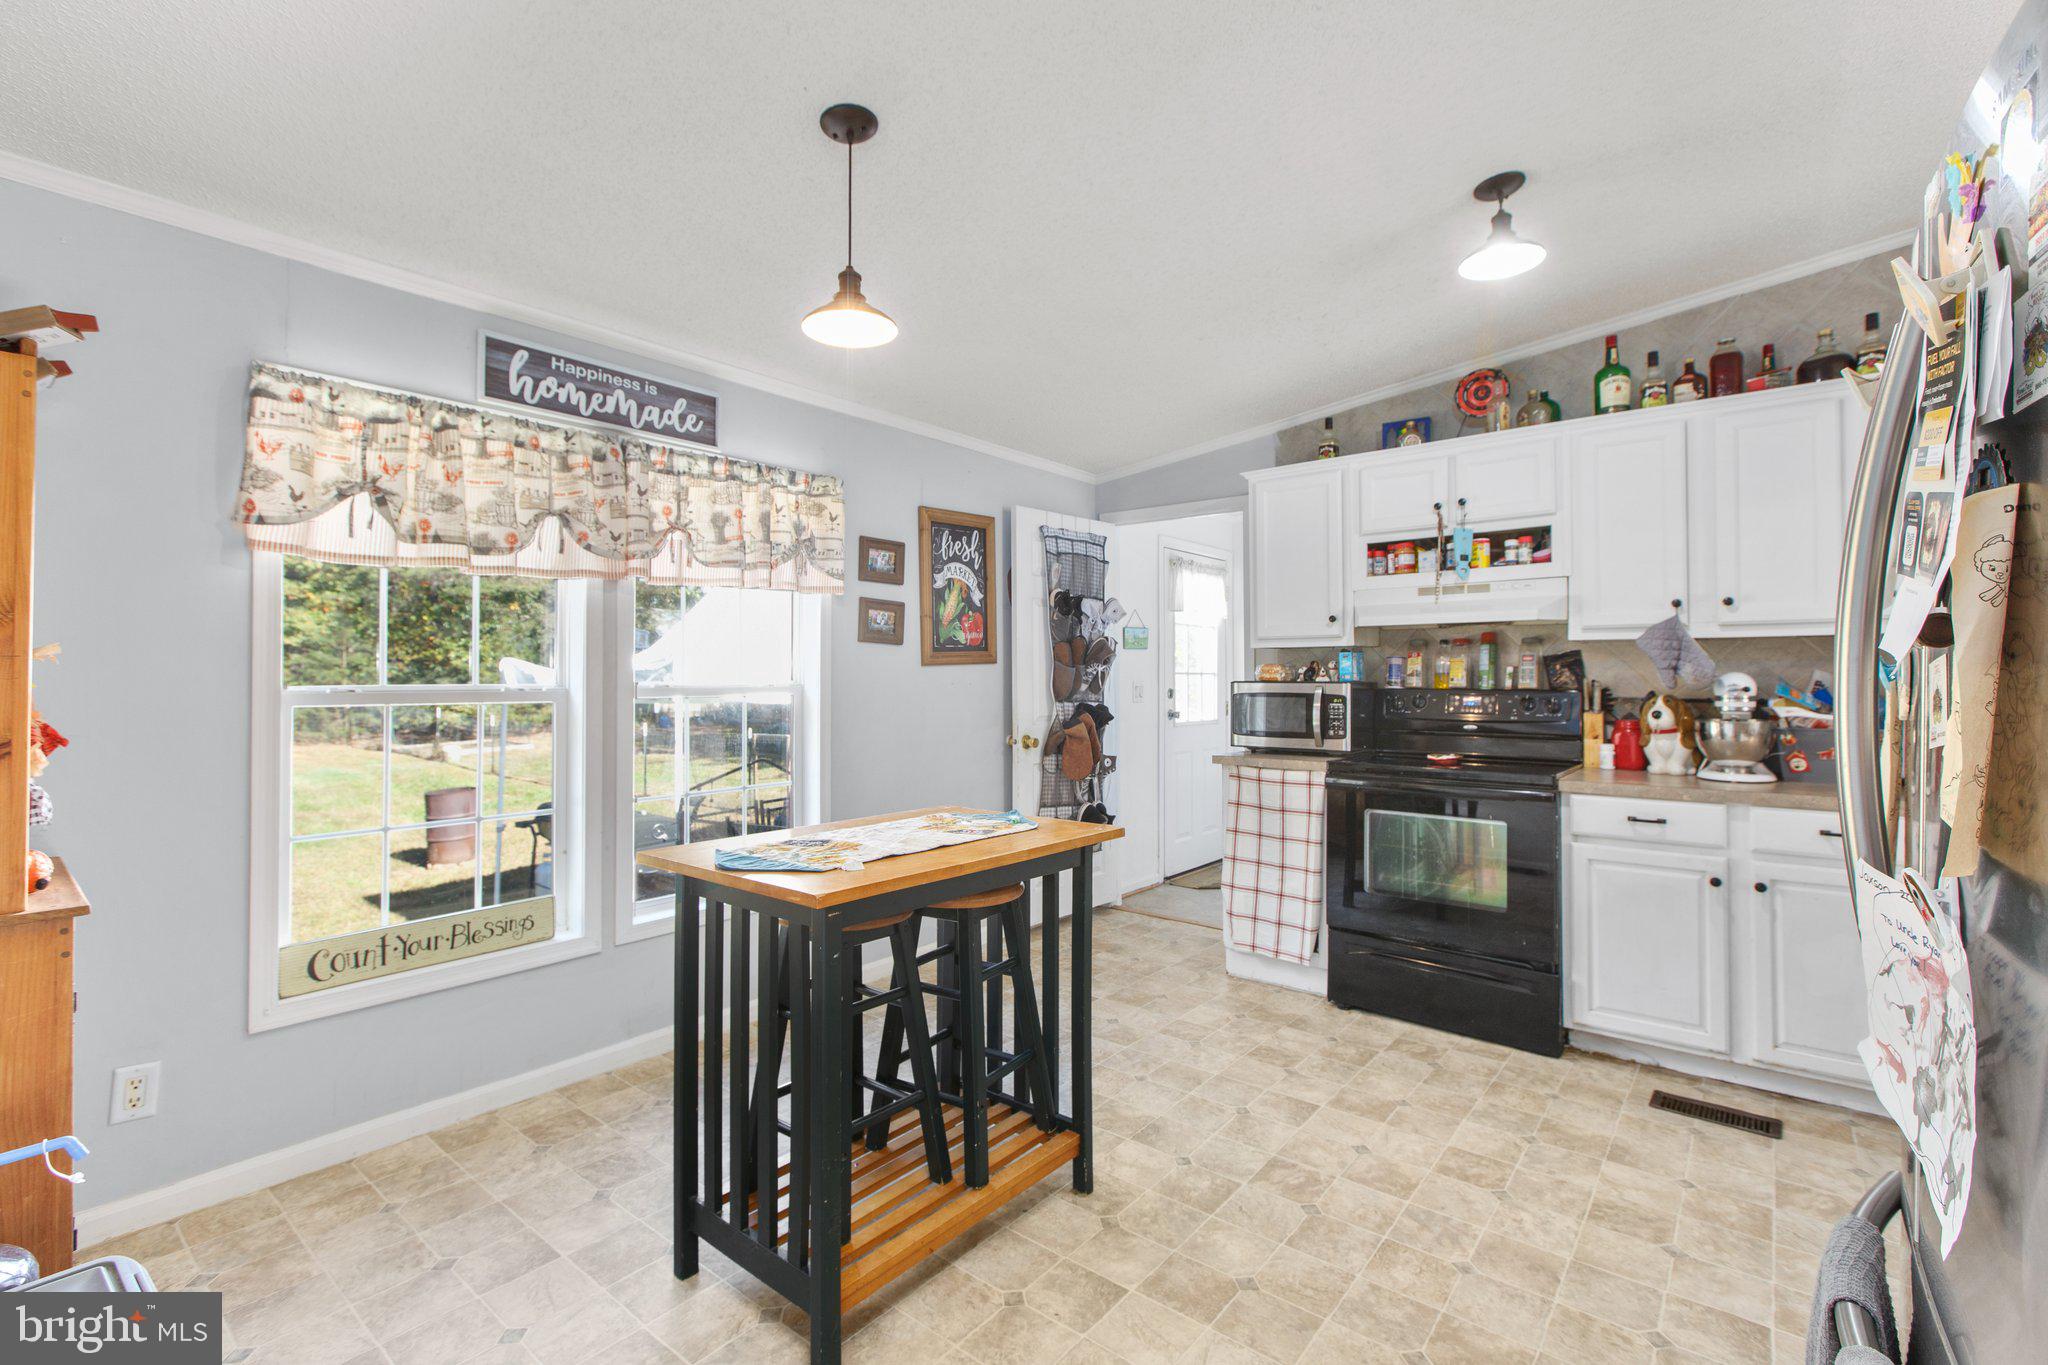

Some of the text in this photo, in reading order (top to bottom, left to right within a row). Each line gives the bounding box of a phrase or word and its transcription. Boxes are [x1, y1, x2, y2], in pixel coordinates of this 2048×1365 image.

[508, 349, 704, 434] homemade
[551, 356, 658, 396] Happiness is
[935, 530, 982, 570] fresh
[944, 565, 977, 588] MARKET
[307, 914, 536, 983] Count Your Blessings
